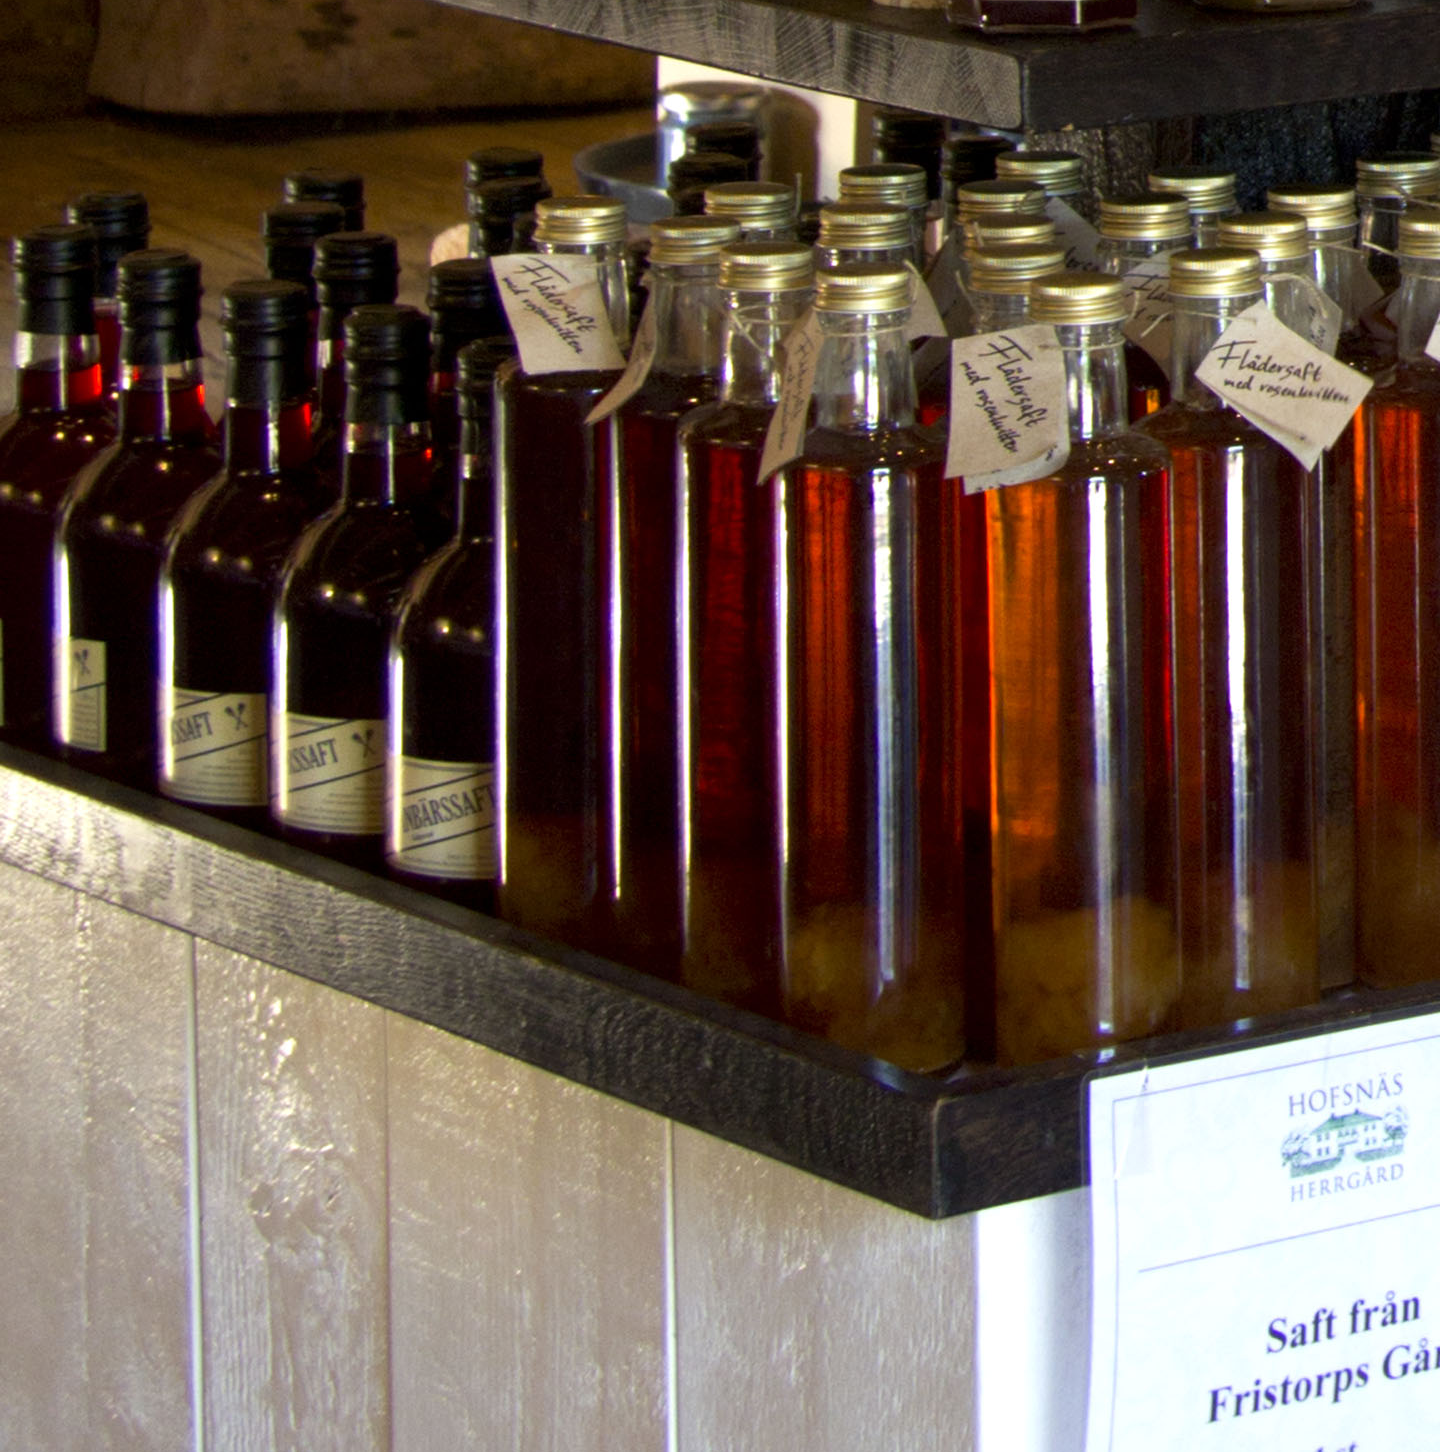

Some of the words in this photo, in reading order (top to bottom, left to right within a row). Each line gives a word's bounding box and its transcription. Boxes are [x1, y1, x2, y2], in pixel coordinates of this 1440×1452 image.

[513, 256, 598, 333] Flädersaft
[960, 361, 992, 386] med
[978, 334, 1048, 428] Flädersaft
[1211, 340, 1323, 383] Flädersaft
[1223, 376, 1253, 391] med
[1288, 1071, 1405, 1118] HOFSNÄS
[1290, 1161, 1406, 1203] HERRGÅRD
[1266, 1306, 1338, 1355] Saft
[1348, 1289, 1423, 1337] från
[1206, 1364, 1371, 1425] Fristorps
